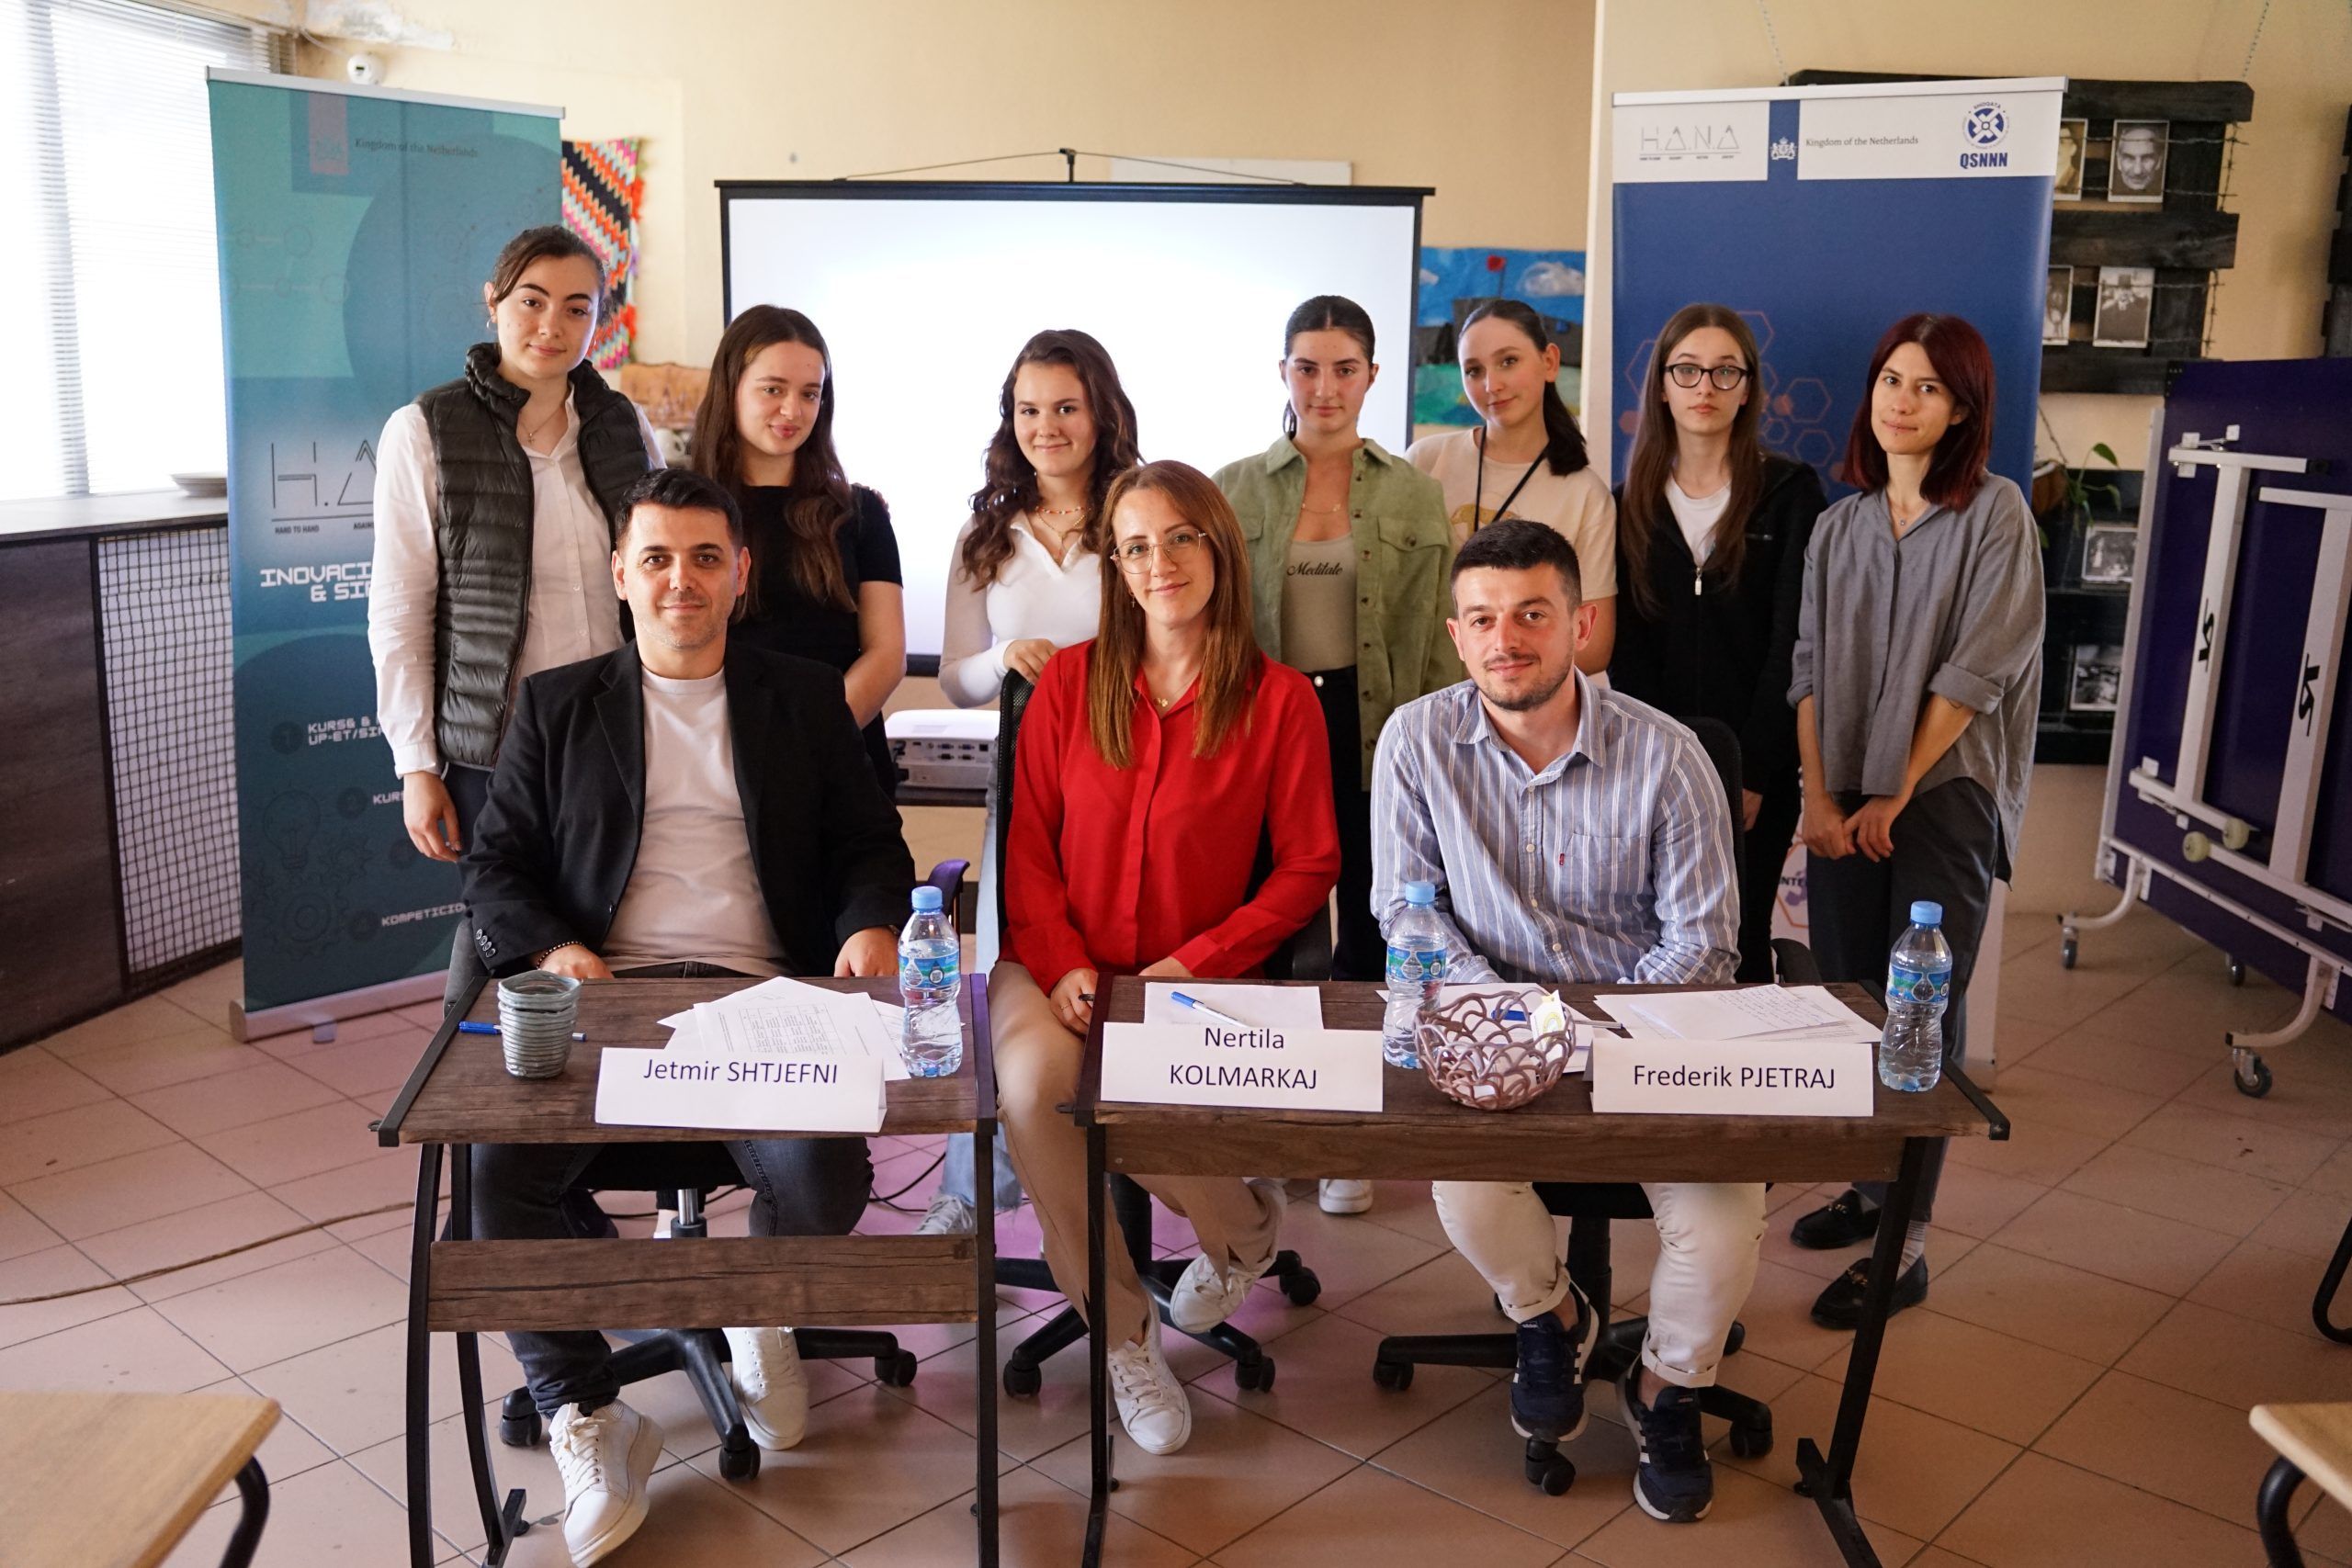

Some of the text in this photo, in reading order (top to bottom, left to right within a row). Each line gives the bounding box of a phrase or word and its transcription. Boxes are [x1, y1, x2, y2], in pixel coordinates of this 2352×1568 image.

[356, 139, 397, 152] Kingdom
[1805, 135, 1919, 149] Kingdom of the Netherlands
[1960, 152, 2008, 170] QSNNN
[259, 561, 371, 588] INOVACI
[1286, 561, 1343, 576] Meditate
[311, 583, 327, 603] &
[1204, 1027, 1284, 1049] Nertila
[644, 1059, 837, 1084] Jetmir SHTJEFNI
[1170, 1064, 1317, 1089] KOLMARKAJ
[1634, 1065, 1835, 1089] Frederik PJETRAJ
